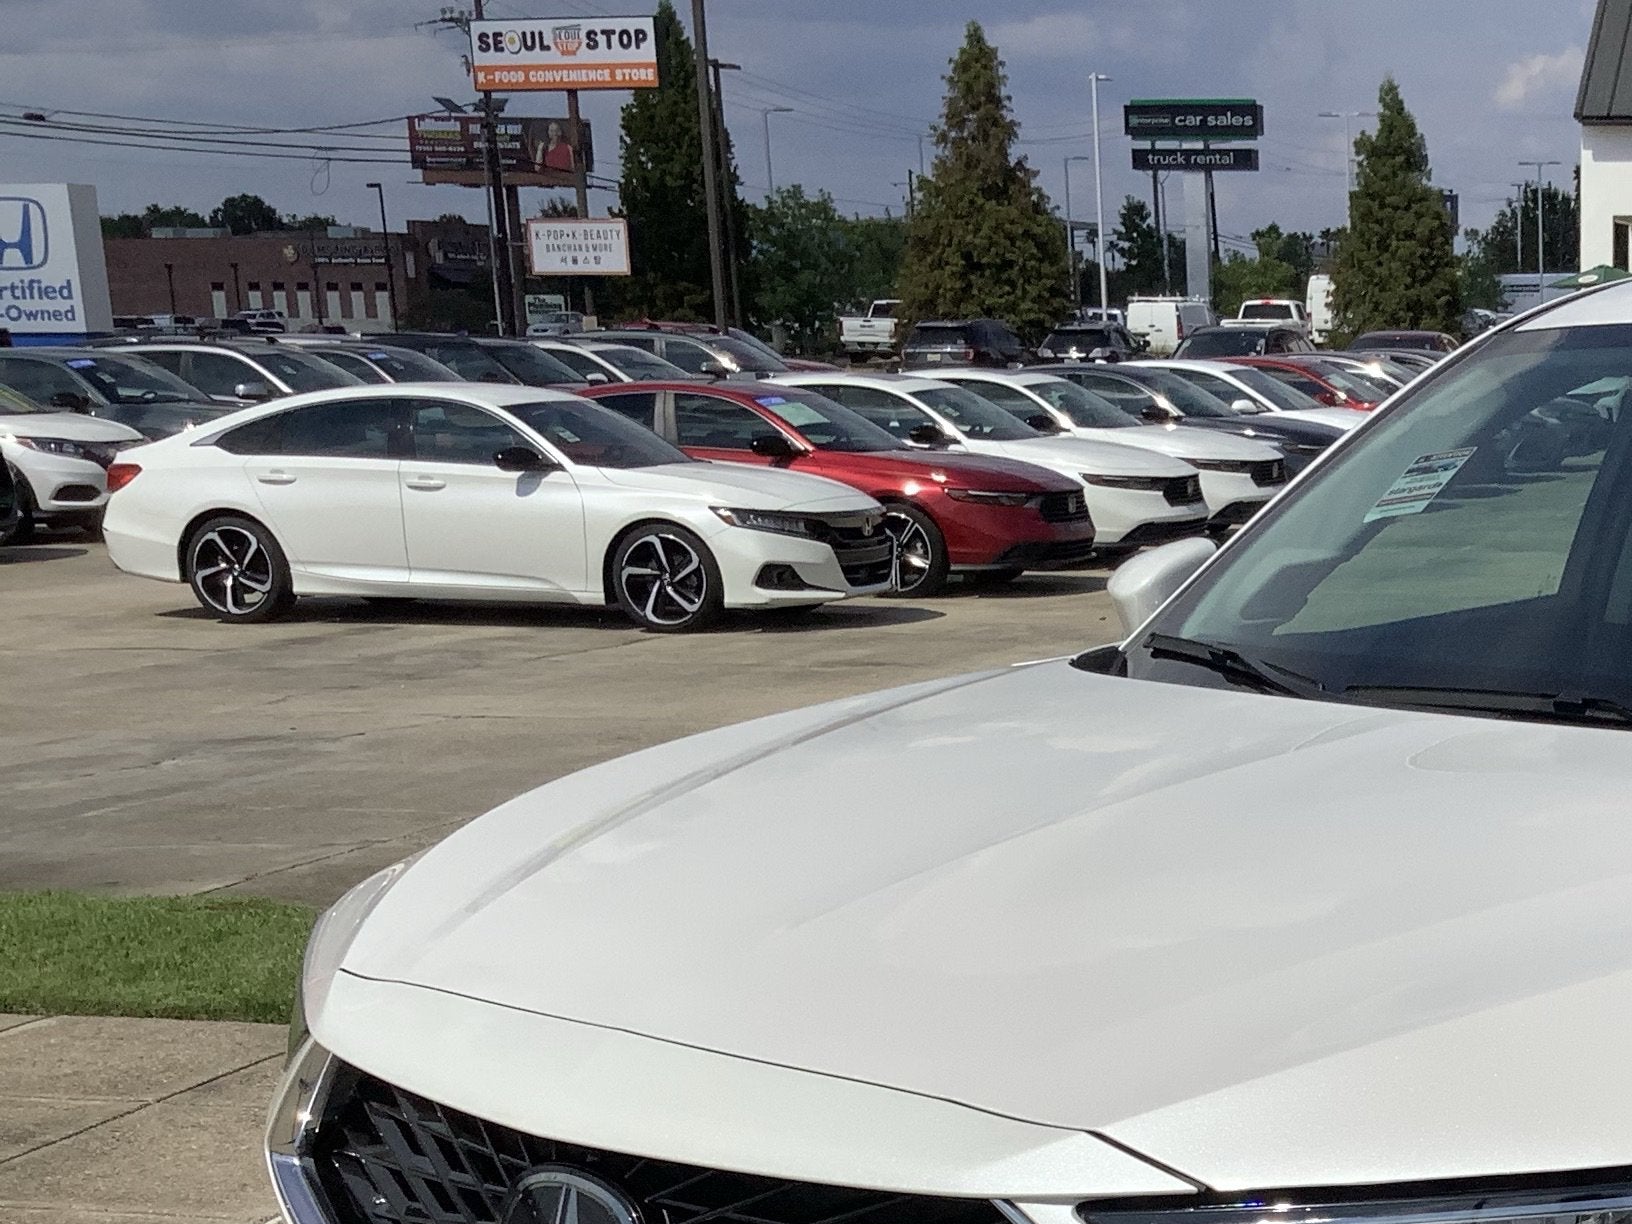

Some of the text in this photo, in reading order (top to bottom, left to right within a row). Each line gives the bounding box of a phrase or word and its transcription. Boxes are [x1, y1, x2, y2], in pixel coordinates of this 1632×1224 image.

[477, 28, 648, 54] SEOUL STOP
[477, 68, 655, 84] K-FOOD CONVENIENCE STORE
[1174, 114, 1203, 126] car
[1207, 110, 1253, 126] sales
[1147, 151, 1234, 165] truck rental
